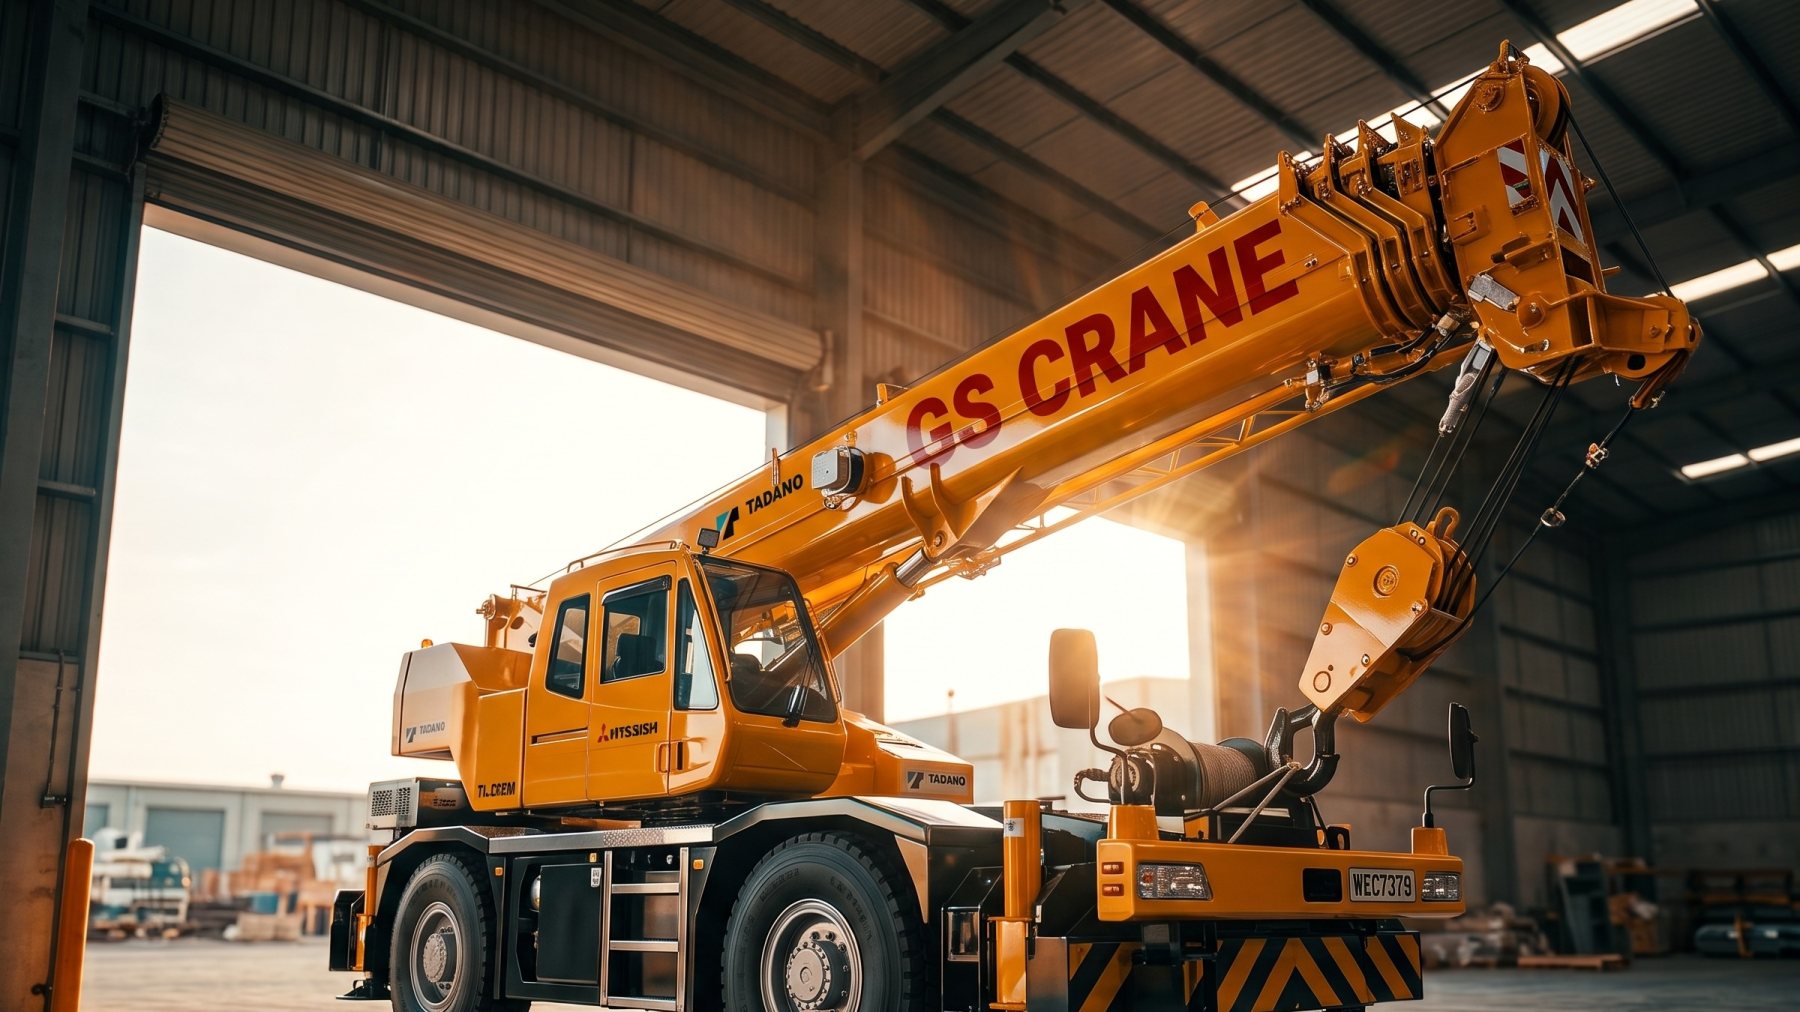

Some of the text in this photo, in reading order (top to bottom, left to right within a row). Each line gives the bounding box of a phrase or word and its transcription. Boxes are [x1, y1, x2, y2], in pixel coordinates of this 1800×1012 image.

[906, 218, 1299, 470] GS CRANE
[745, 474, 803, 514] TADANO
[928, 773, 966, 786] TADANO
[1353, 873, 1412, 897] WEC7379
